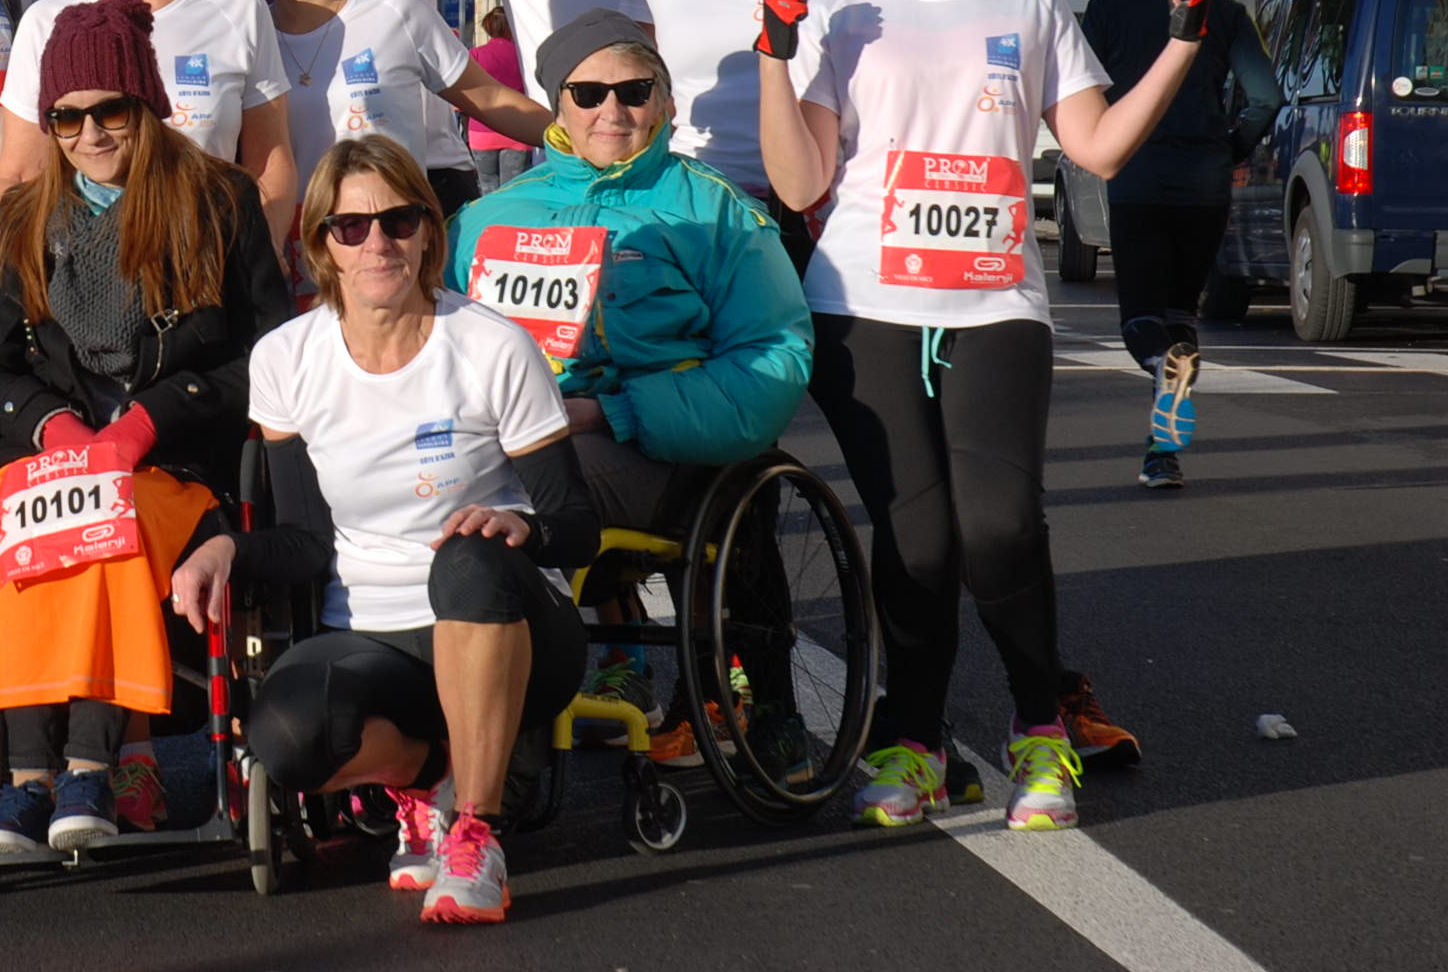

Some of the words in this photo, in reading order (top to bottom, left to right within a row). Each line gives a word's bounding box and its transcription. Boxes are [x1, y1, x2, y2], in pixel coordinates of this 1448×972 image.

[923, 156, 989, 178] PROM
[924, 179, 988, 192] CLASSIC
[909, 203, 999, 239] 10027
[515, 231, 573, 252] PROM
[964, 271, 1013, 284] Kalenji
[495, 272, 579, 310] 10103
[26, 448, 89, 480] PROM
[15, 484, 102, 529] 10101
[74, 536, 126, 555] Kalenji
